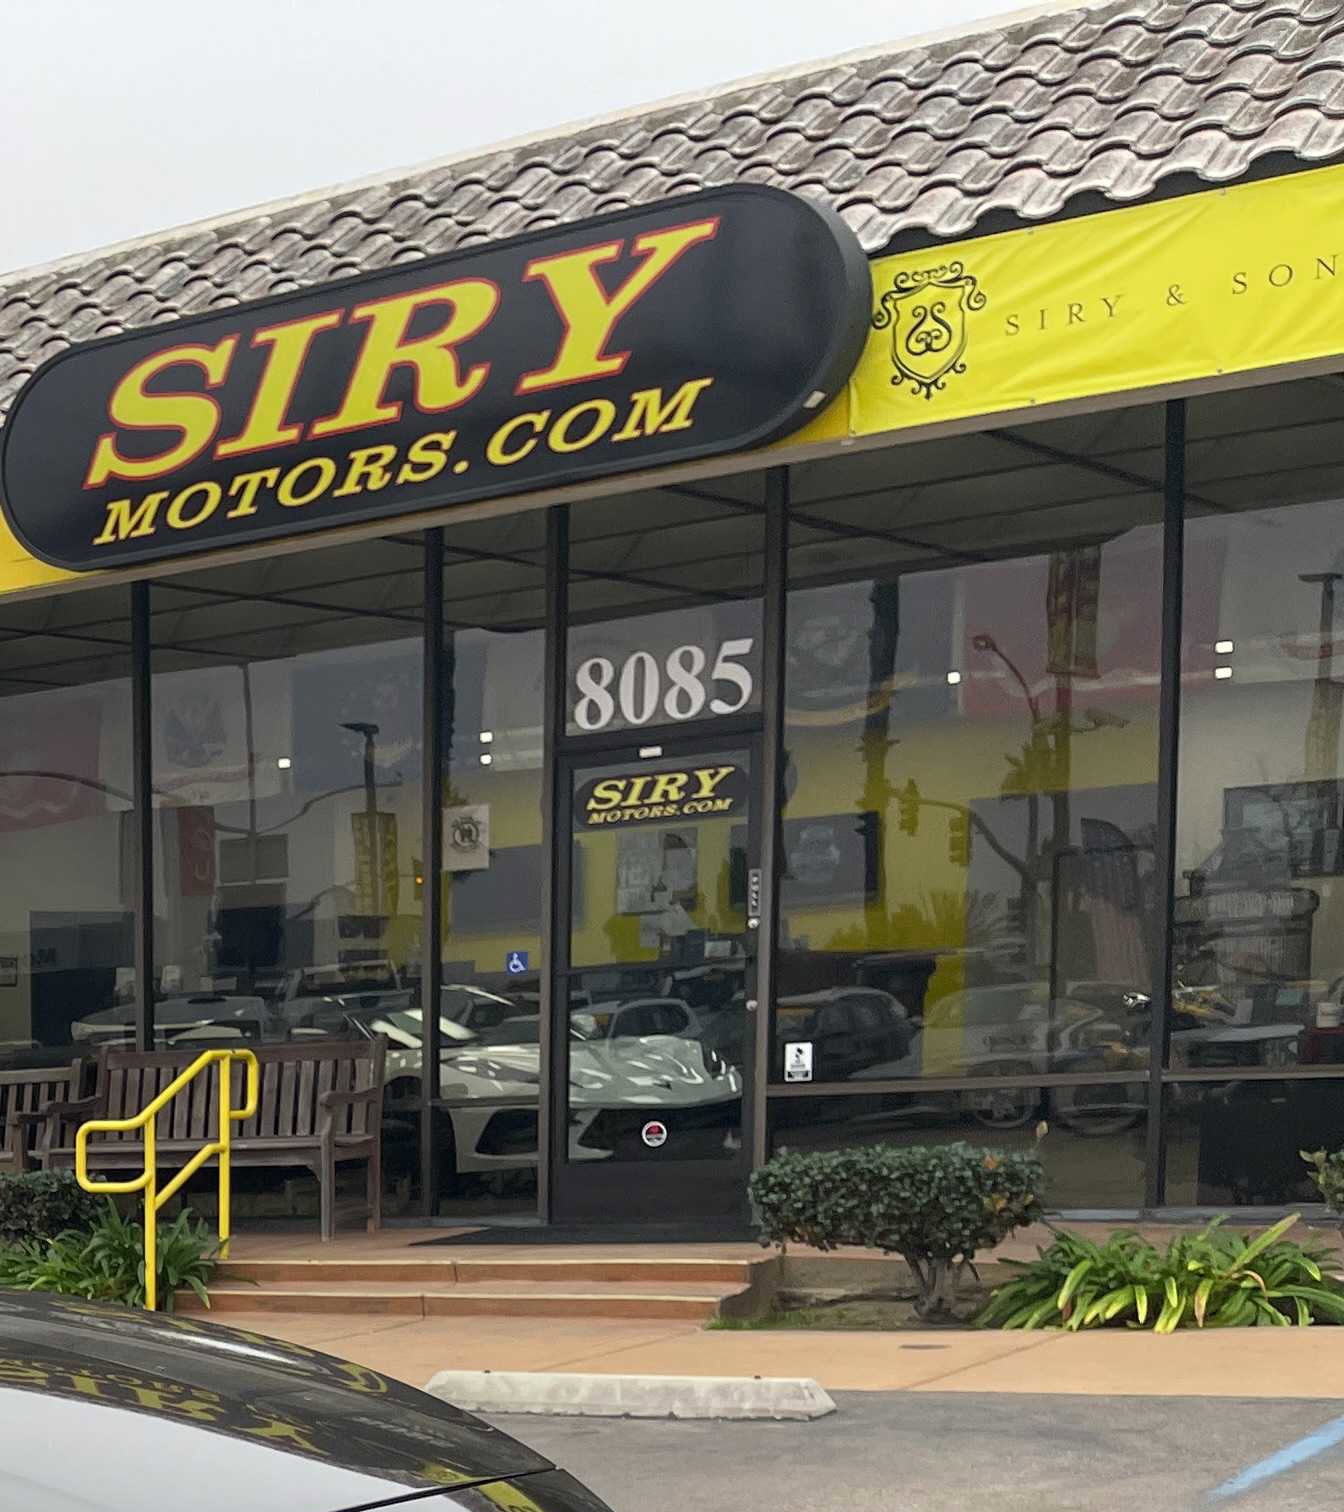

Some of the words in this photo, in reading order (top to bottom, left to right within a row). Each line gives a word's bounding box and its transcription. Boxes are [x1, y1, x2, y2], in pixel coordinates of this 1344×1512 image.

[1006, 293, 1124, 337] SIRY
[1166, 284, 1188, 308] &
[83, 217, 721, 489] SIRY
[93, 378, 712, 546] MOTORS.COM
[575, 639, 754, 731] 8085
[587, 766, 736, 812] SIRY
[588, 797, 734, 826] MOTORS.COM
